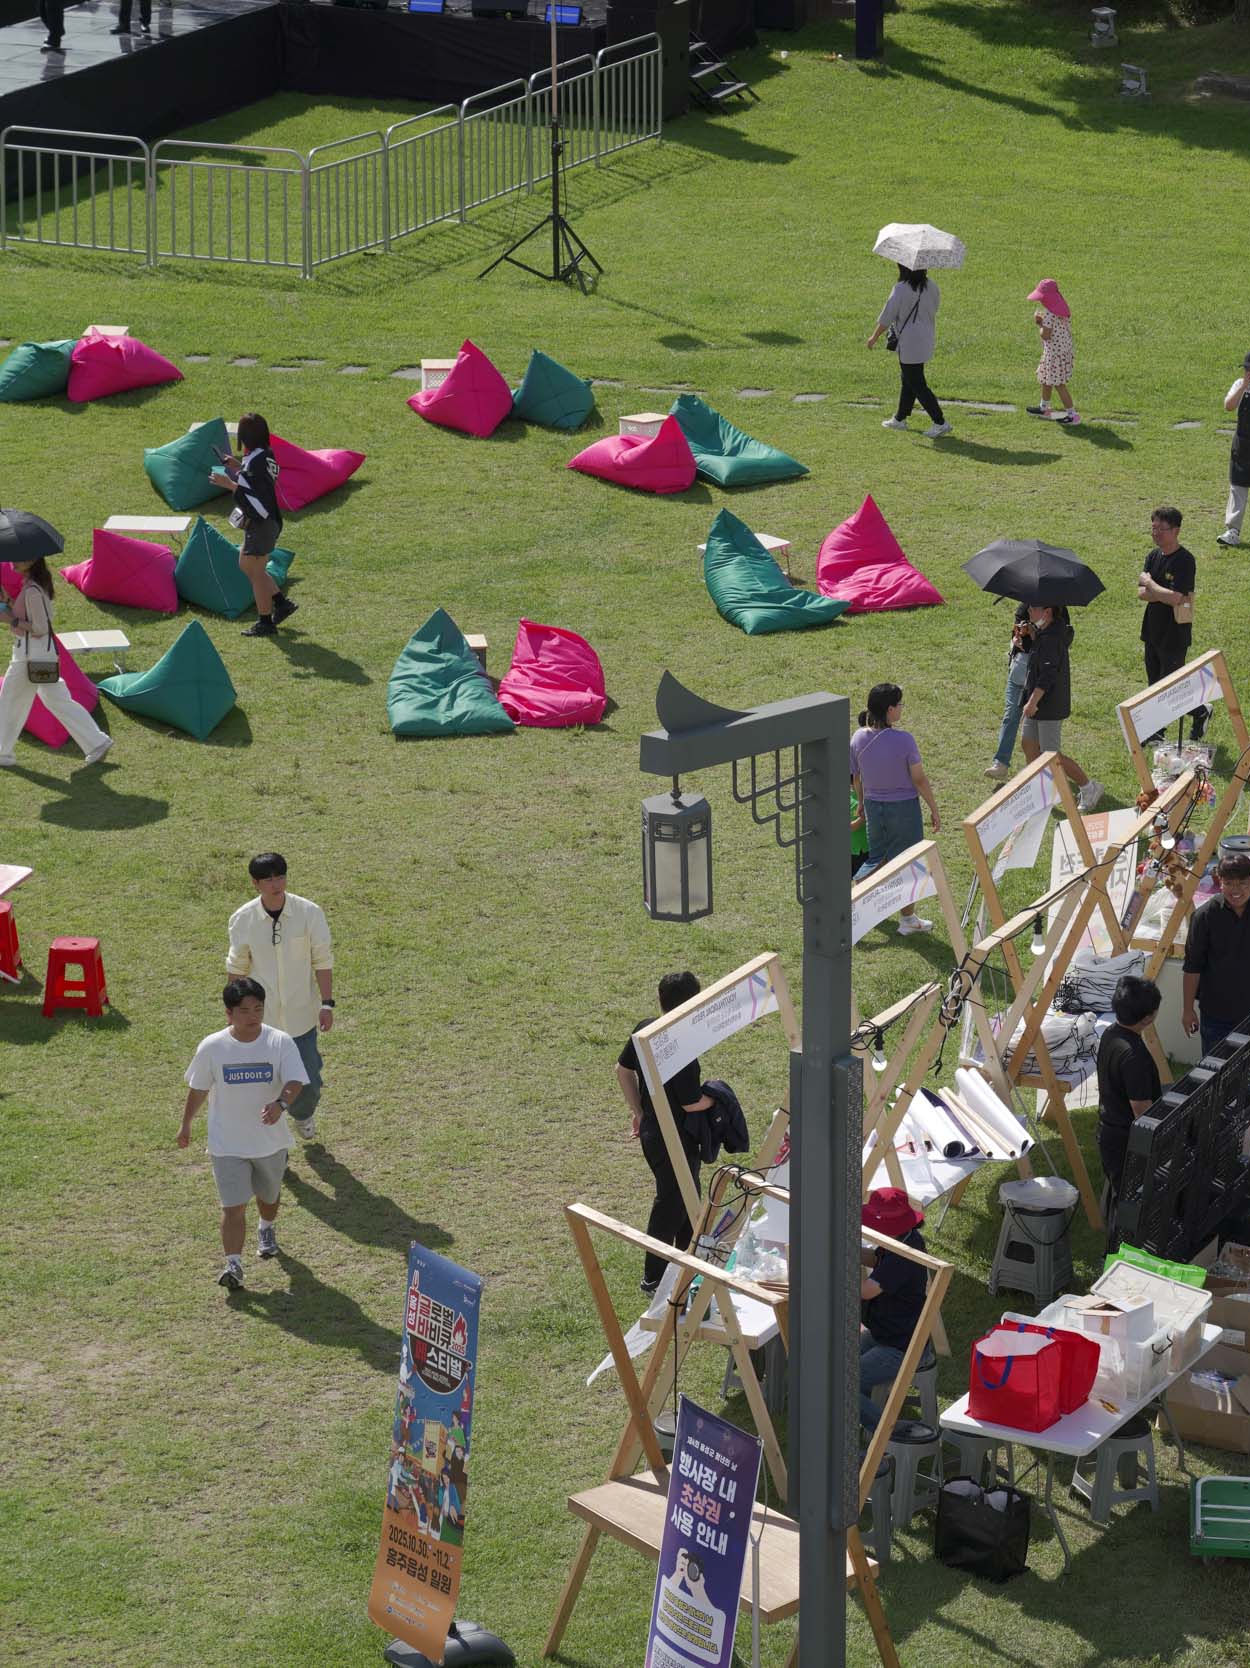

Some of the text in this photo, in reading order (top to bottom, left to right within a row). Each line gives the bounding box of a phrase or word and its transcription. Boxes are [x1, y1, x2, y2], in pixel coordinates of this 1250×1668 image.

[229, 1071, 263, 1081] JUST DO IT
[417, 1316, 452, 1350] 바비큐
[419, 1295, 454, 1330] 글로벌
[415, 1339, 462, 1381] 페스티벌
[451, 1343, 465, 1355] 2025
[678, 1450, 737, 1504] 행사장 내
[680, 1483, 722, 1525] 초상권
[671, 1504, 728, 1556] 사용 안내
[386, 1548, 451, 1595] 홍주읍성 일원
